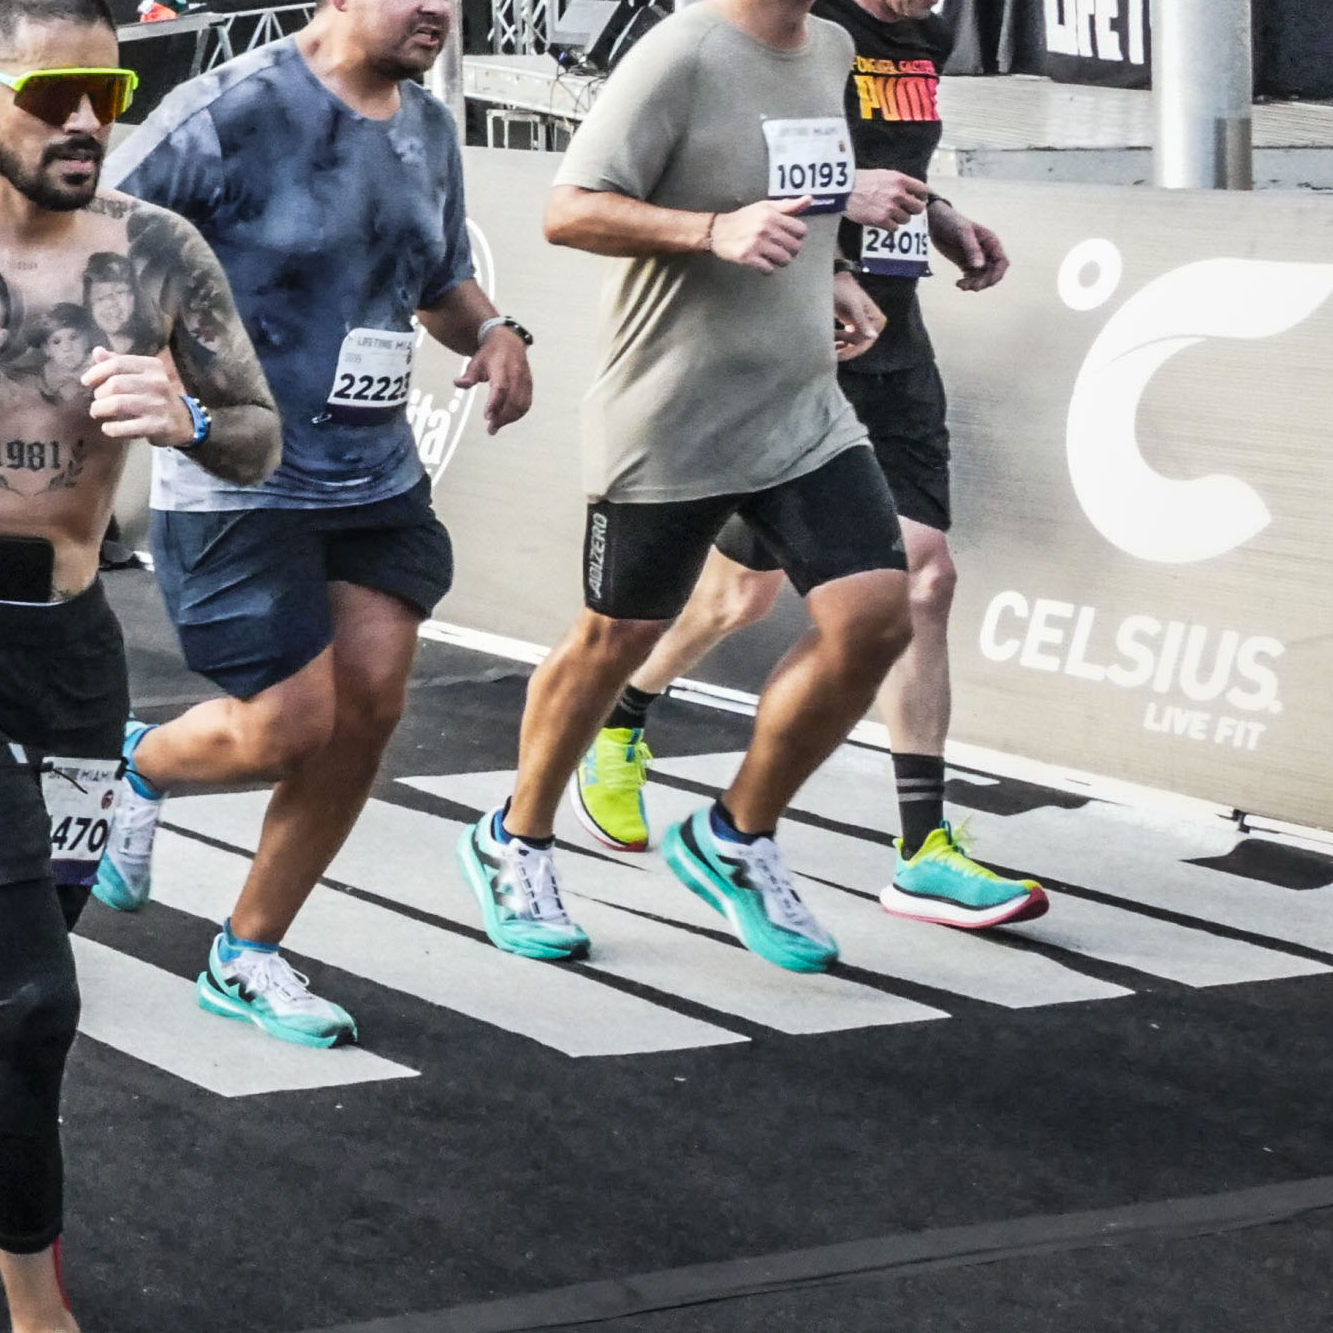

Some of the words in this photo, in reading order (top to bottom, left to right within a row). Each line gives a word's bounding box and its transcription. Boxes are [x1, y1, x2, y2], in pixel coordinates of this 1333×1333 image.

[777, 160, 849, 190] 10193
[588, 512, 608, 599] ADIZERO
[979, 589, 1282, 714] CELSIUS
[1143, 701, 1208, 742] LIVE
[1215, 714, 1267, 752] FIT
